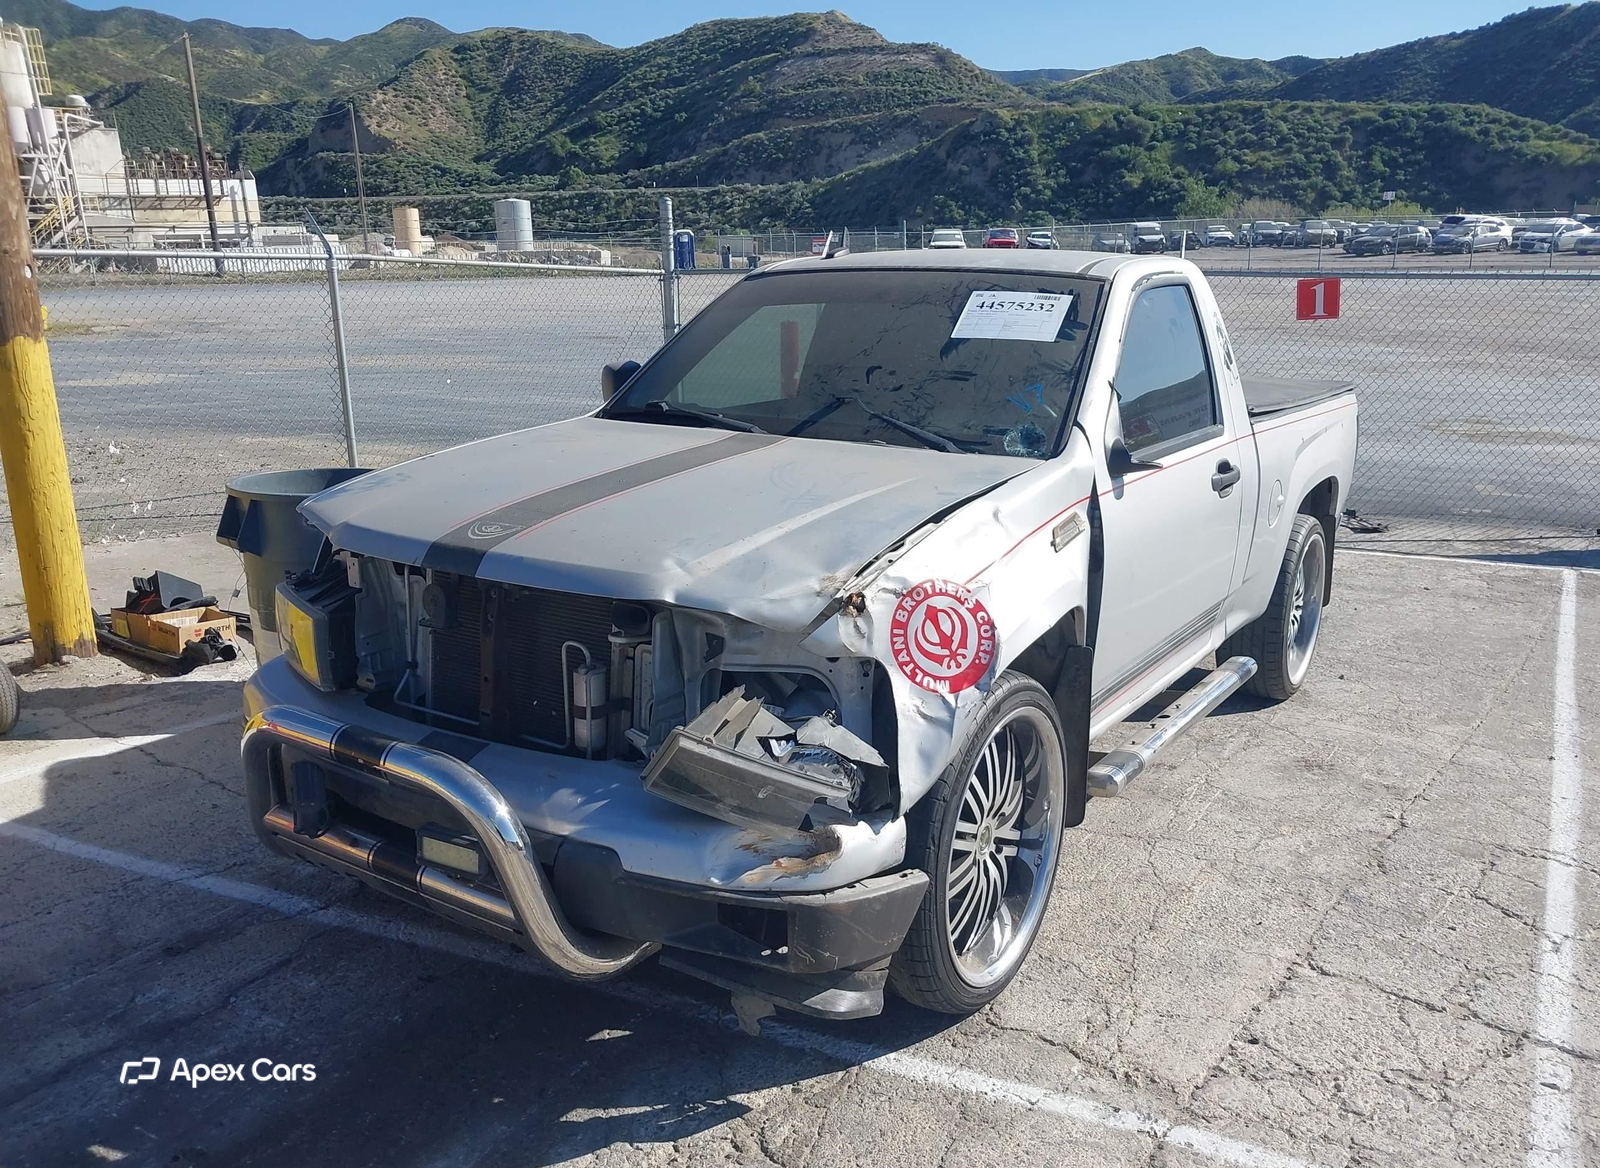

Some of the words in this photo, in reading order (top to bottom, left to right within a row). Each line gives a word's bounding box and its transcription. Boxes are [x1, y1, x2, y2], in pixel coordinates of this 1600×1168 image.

[975, 300, 1055, 313] 44575232
[1310, 282, 1329, 317] 1
[895, 578, 977, 623] BROTHERS
[892, 628, 951, 692] MULTANI
[975, 611, 993, 665] CORP.
